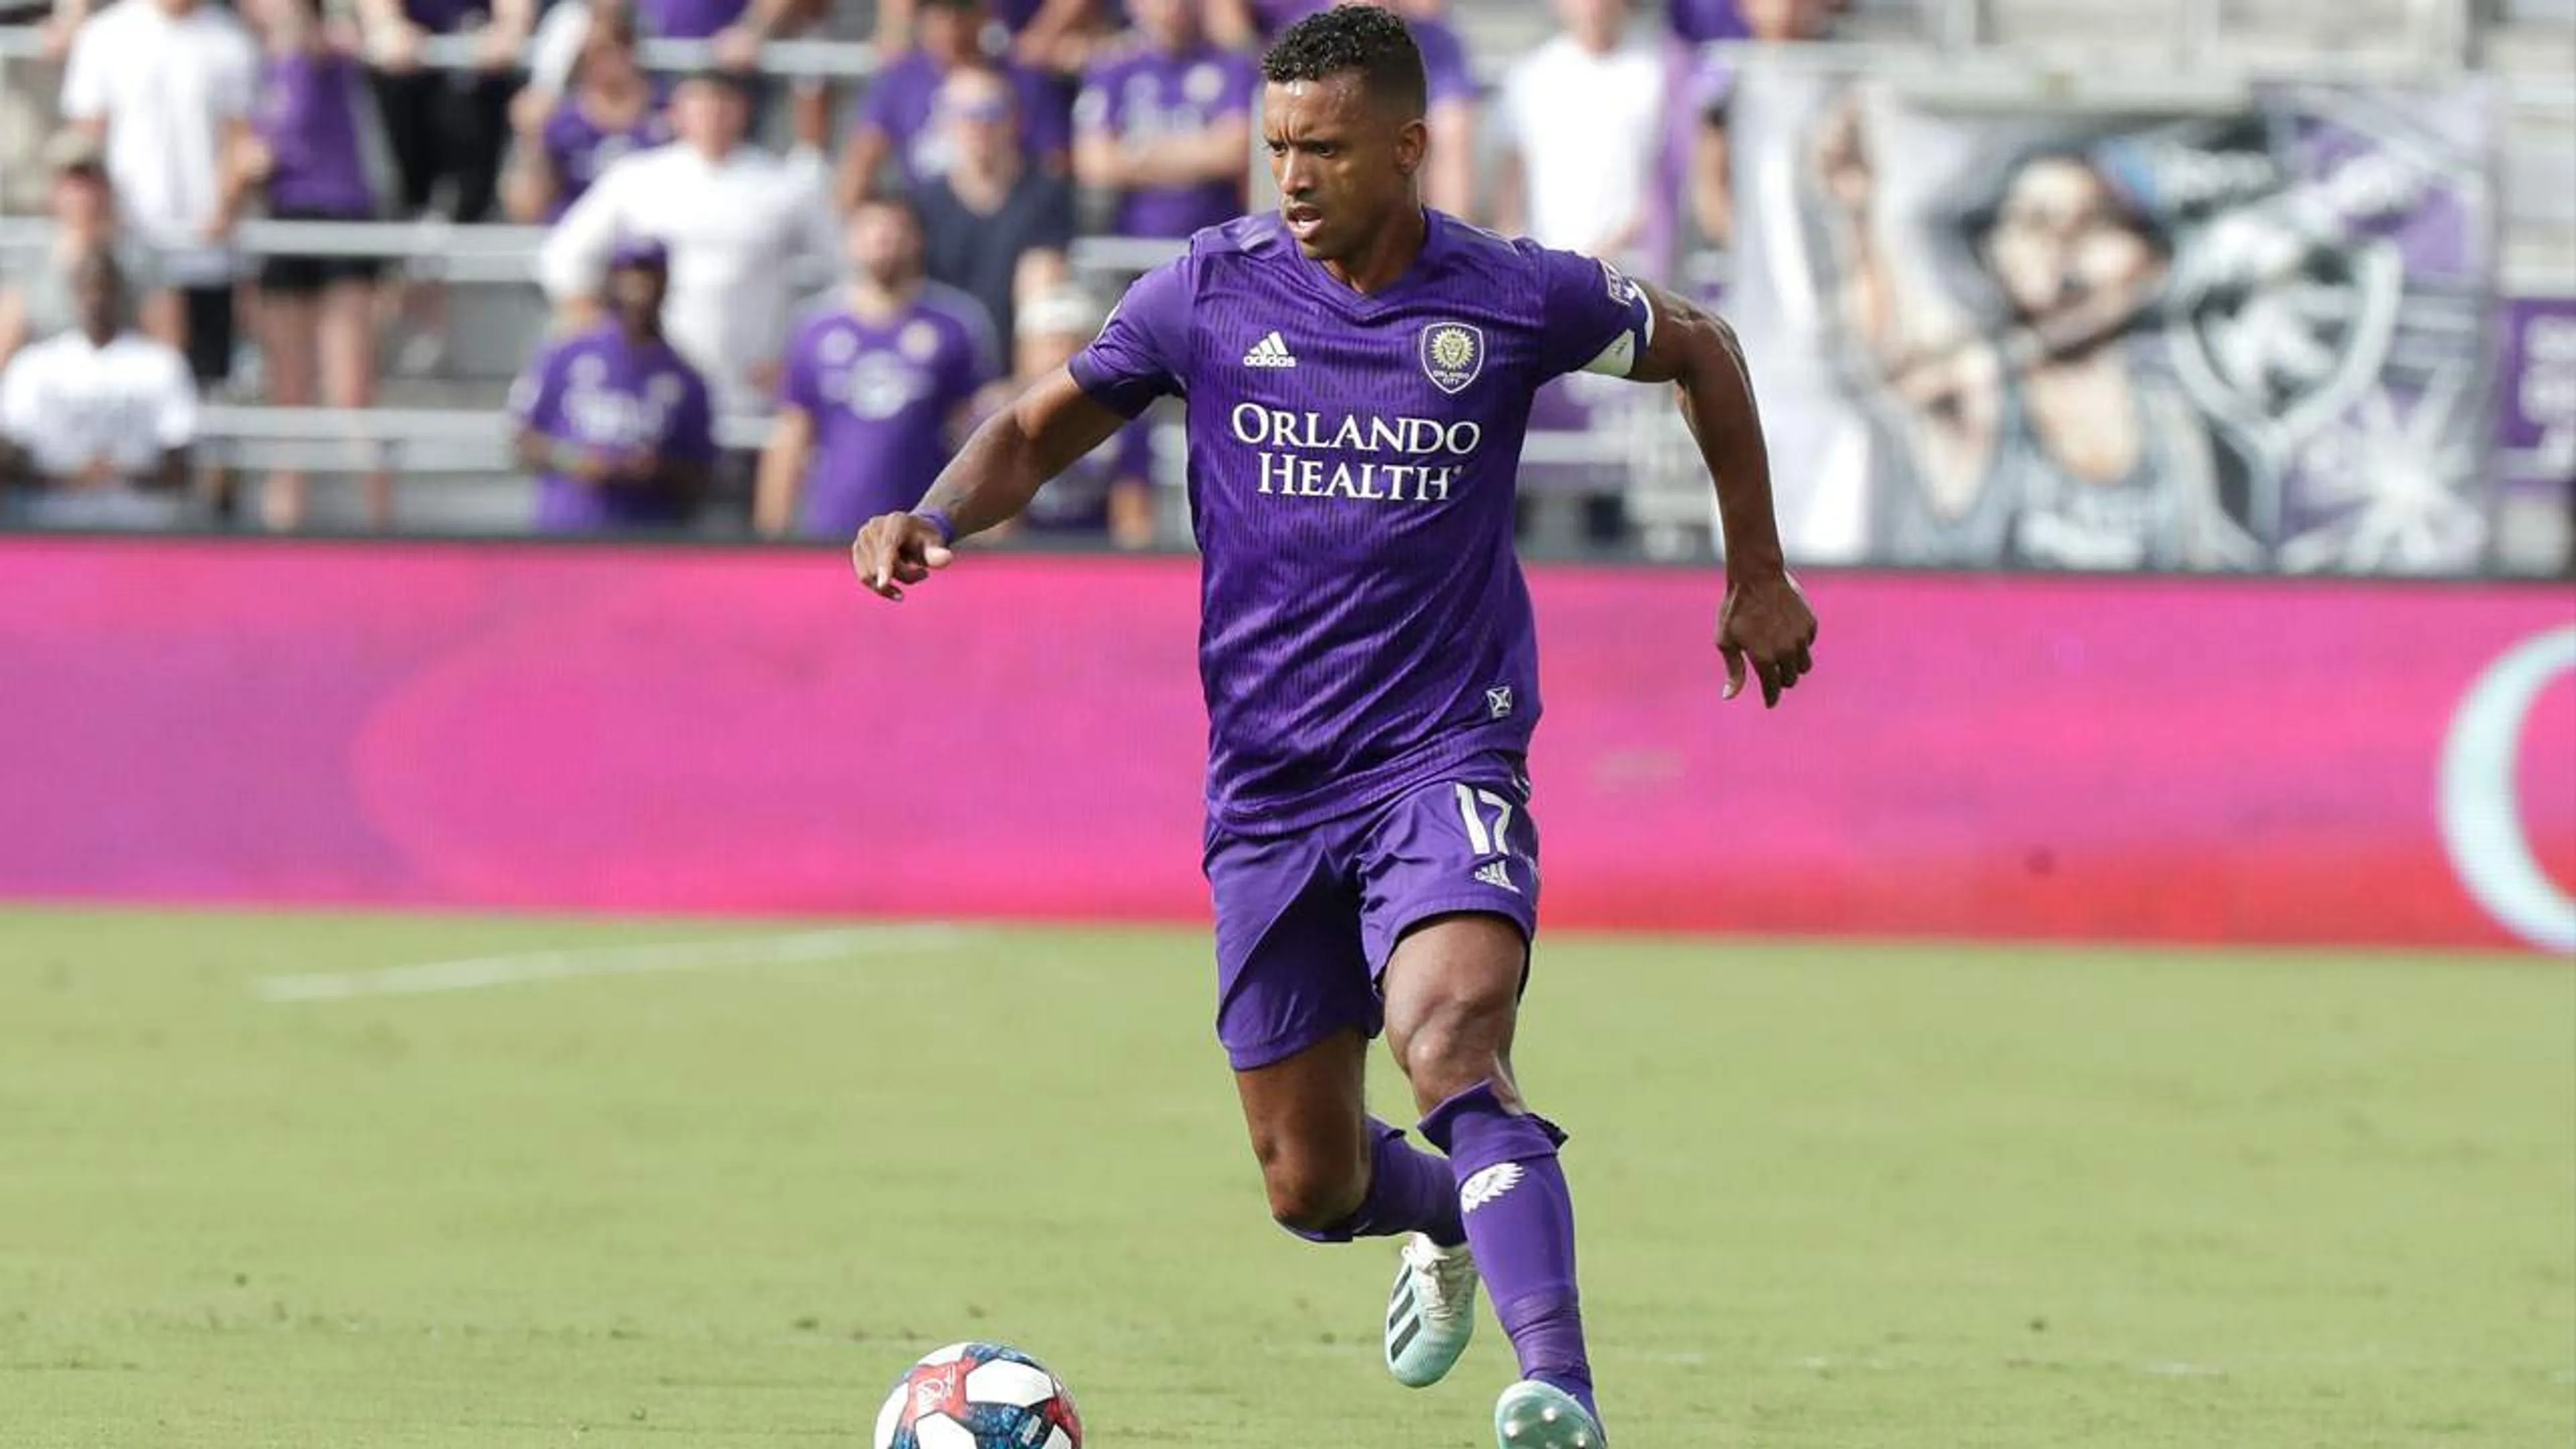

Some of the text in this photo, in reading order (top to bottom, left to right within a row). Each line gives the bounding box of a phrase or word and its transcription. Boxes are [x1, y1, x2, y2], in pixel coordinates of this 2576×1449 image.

[1243, 352, 1297, 368] adidas
[1232, 402, 1481, 454] ORLANDO
[1454, 782, 1512, 856] 17
